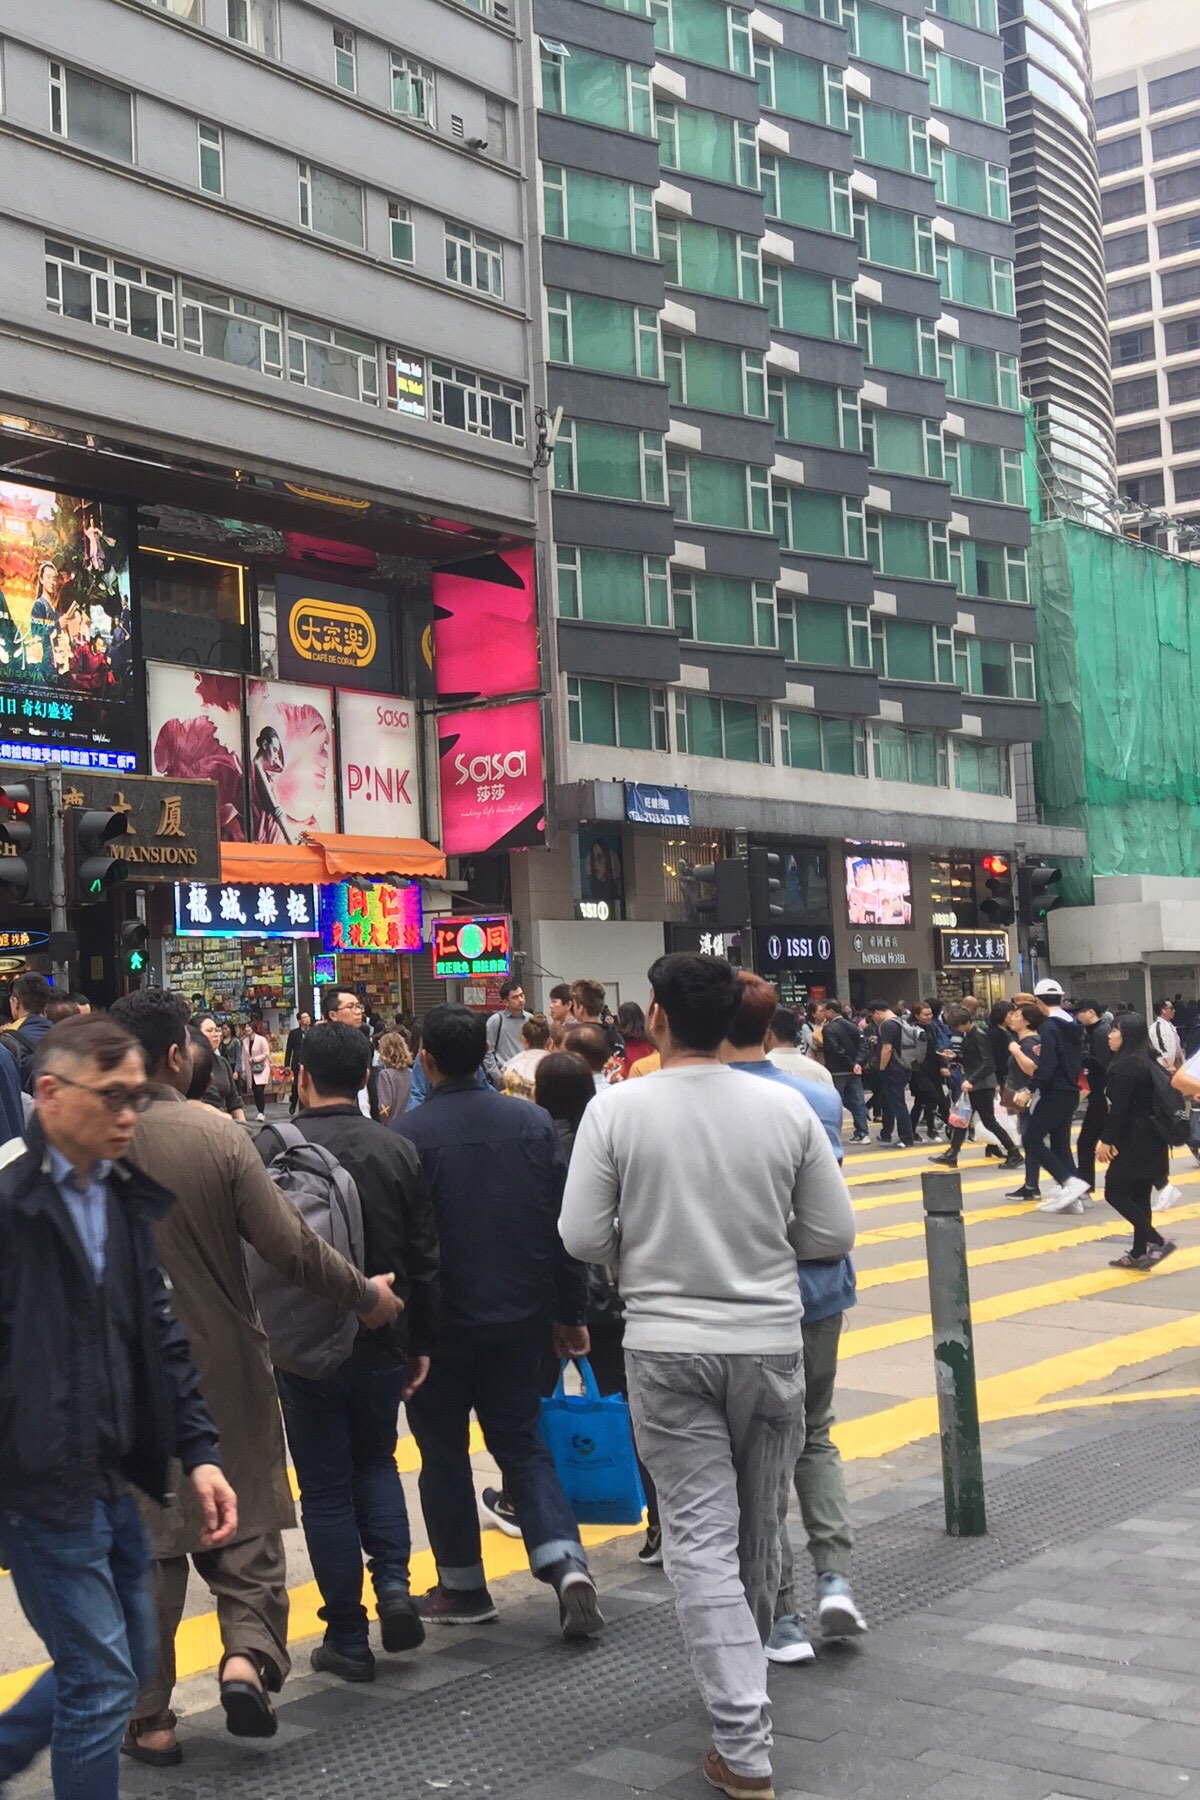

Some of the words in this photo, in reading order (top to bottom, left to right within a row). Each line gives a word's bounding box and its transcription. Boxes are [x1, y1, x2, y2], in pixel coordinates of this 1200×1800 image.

[328, 653, 337, 664] DE
[21, 698, 74, 722] 奇幻盛宴
[347, 763, 412, 805] P!NK
[476, 784, 506, 803] 莎莎
[787, 938, 813, 957] ISSI
[888, 952, 907, 964] HOTEL
